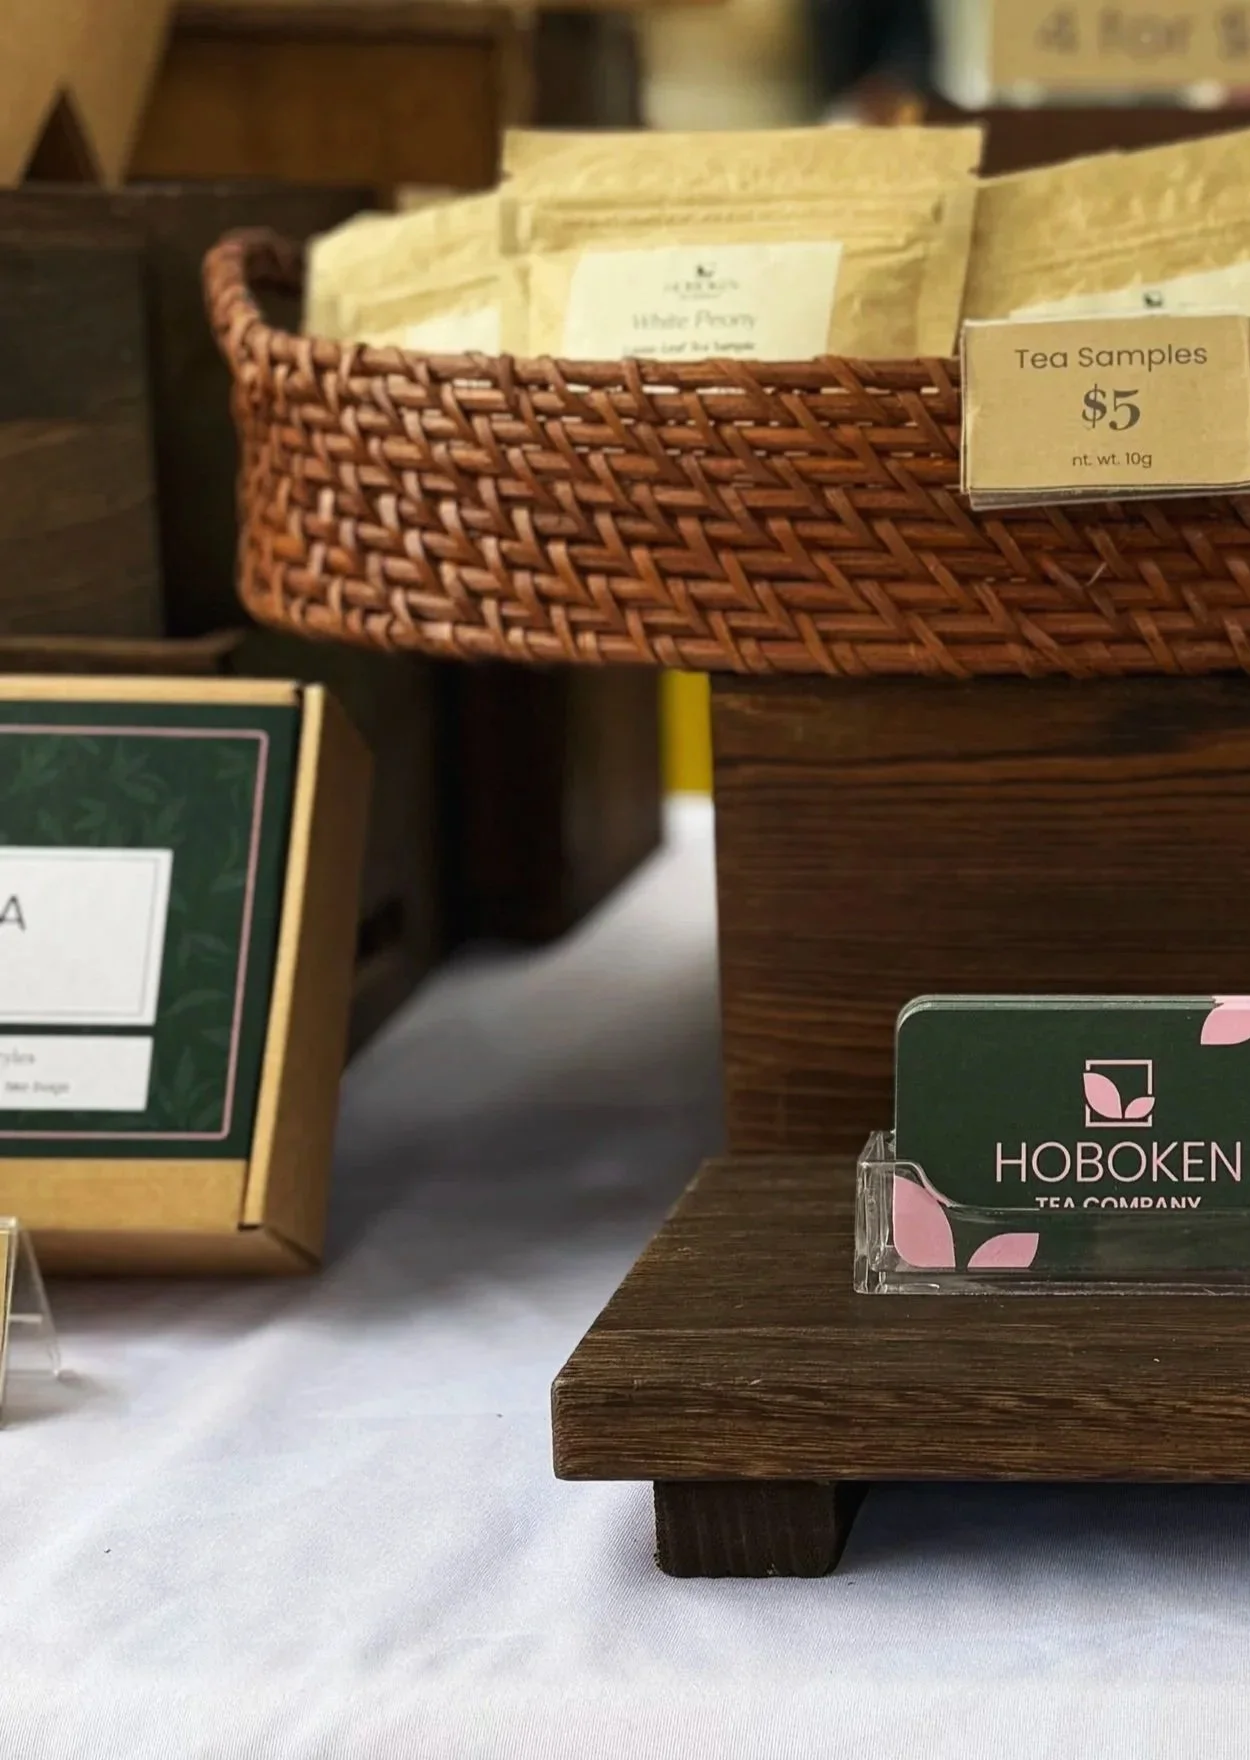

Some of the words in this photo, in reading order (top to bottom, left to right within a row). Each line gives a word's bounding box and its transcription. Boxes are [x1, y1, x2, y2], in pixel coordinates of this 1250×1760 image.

[1035, 8, 1080, 55] 4
[1097, 8, 1193, 59] for
[632, 312, 689, 330] White
[694, 309, 756, 332] Peony
[1013, 348, 1068, 369] Tea
[1077, 343, 1208, 373] Samples
[1081, 383, 1141, 431] $5
[1072, 453, 1093, 467] nt.
[1096, 453, 1121, 467] wt.
[1125, 451, 1153, 468] 10g
[995, 1140, 1242, 1183] HOBOKEN
[1035, 1196, 1075, 1209] TEA
[1082, 1196, 1202, 1209] COMPANY
